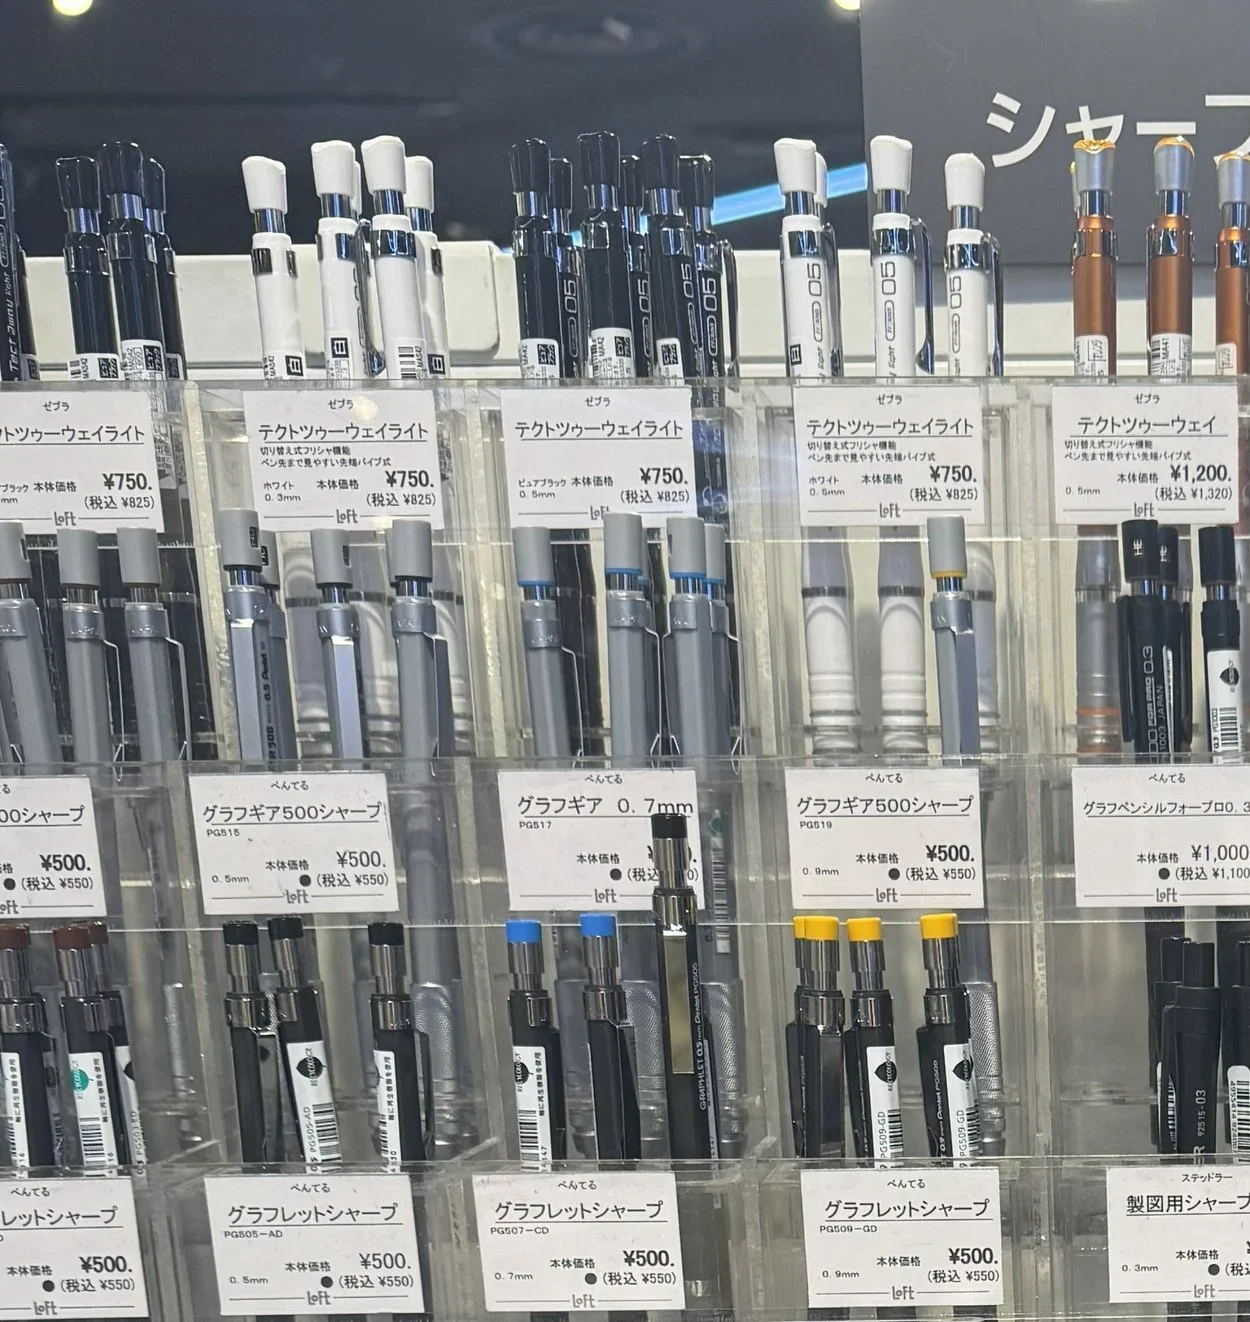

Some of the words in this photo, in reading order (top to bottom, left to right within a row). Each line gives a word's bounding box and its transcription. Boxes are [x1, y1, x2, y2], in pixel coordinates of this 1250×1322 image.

[328, 398, 353, 410] ゼブラ
[258, 422, 428, 440] テクトツゥーウェイライト
[515, 420, 683, 438] テクトツゥーウェイライト
[807, 418, 973, 436] テクトツゥーウェイライト
[1078, 415, 1216, 434] テクトツゥーウェイ
[263, 481, 294, 490] ホワイト
[1117, 472, 1158, 483] 本体価格
[403, 493, 436, 506] ¥825)
[1191, 486, 1232, 500] ¥1,320)
[203, 801, 382, 823] グラフギア500シャープ
[518, 795, 603, 815] グラフギア
[797, 795, 974, 814] グラフギア500シャープ
[206, 828, 240, 837] PG515
[519, 821, 551, 829] PG517
[265, 859, 309, 871] 本体価格
[354, 872, 389, 886] ¥550)
[228, 1202, 398, 1224] グラフレットシャープ
[495, 1200, 664, 1220] グラフレットシャープ
[825, 1198, 990, 1219] グラフレットシャープ
[378, 1275, 414, 1287] ¥550)
